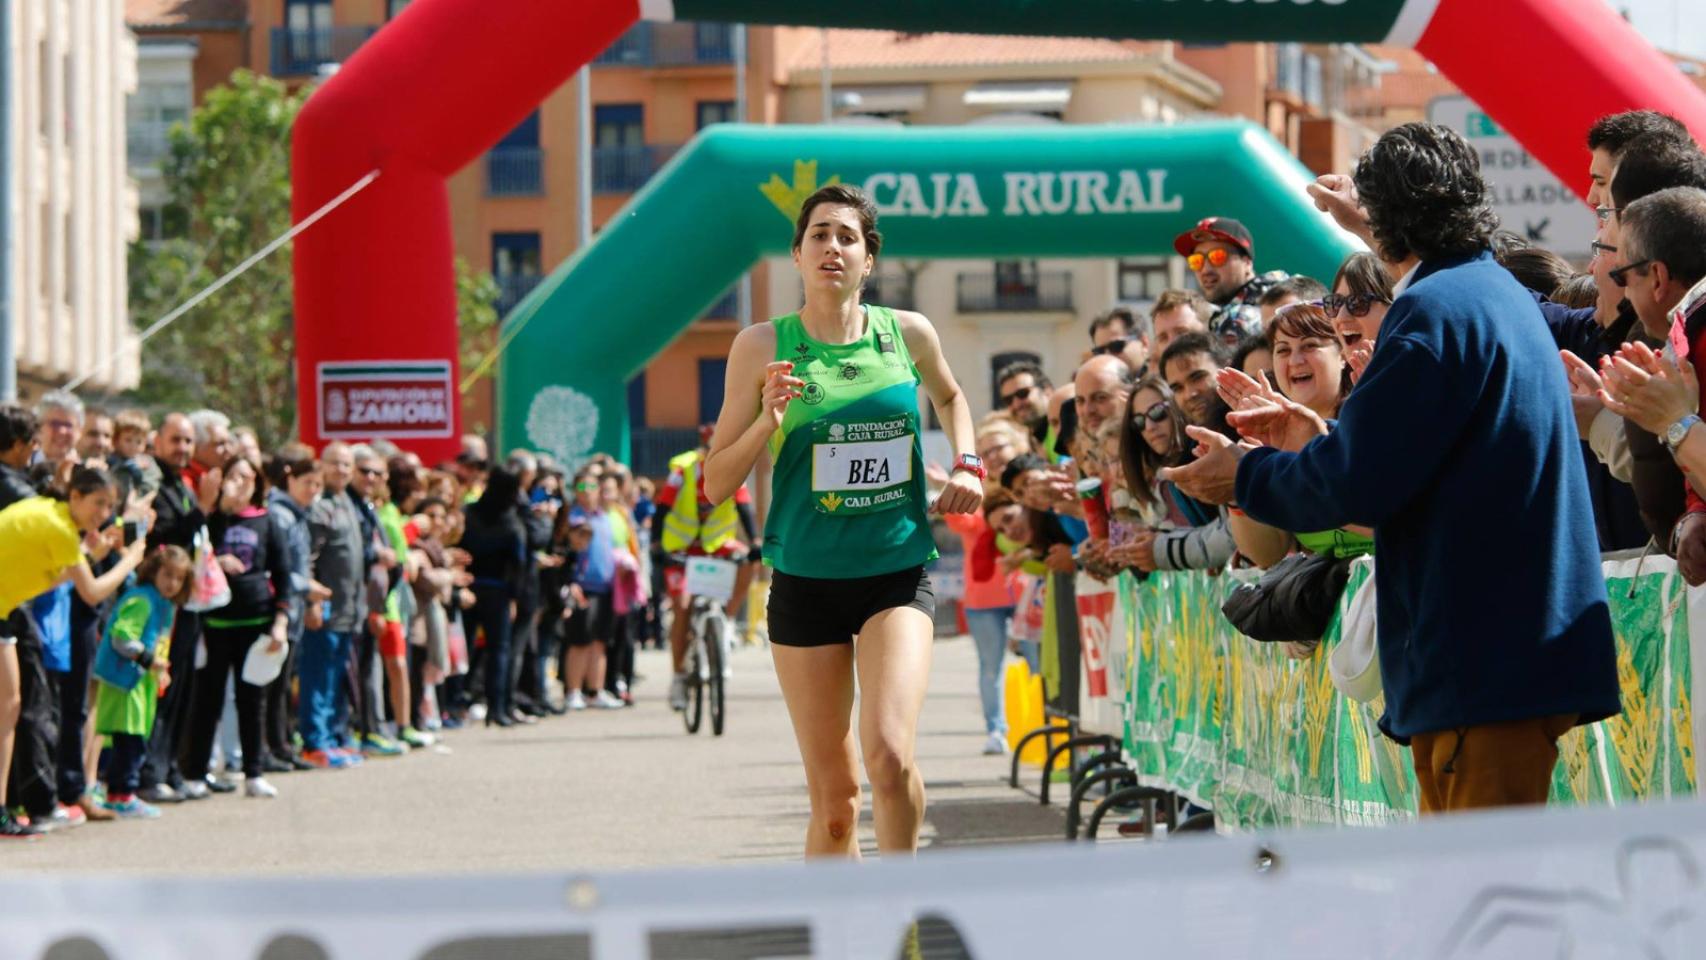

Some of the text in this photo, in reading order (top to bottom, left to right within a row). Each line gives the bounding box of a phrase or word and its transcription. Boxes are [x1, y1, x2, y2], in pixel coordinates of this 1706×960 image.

[864, 169, 1184, 218] CAJA RURAL
[348, 401, 447, 423] ZAMORA
[847, 428, 904, 441] CAJA RURAL
[830, 447, 837, 458] 5
[847, 457, 890, 485] BEA
[844, 488, 906, 507] CAJA RURAL
